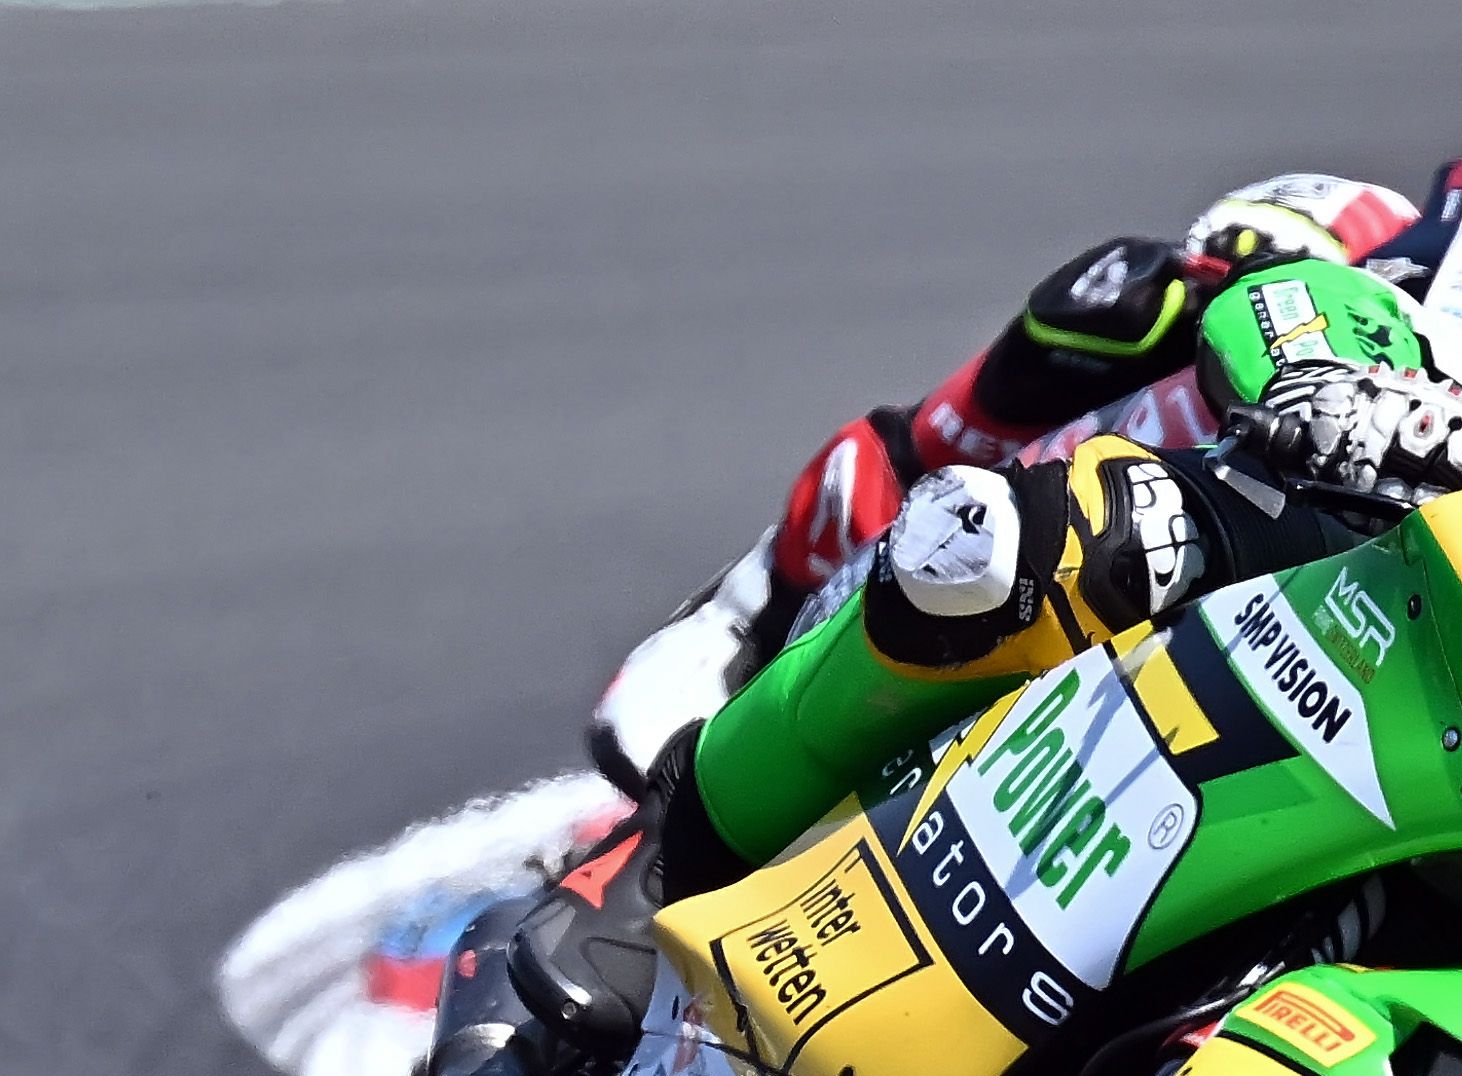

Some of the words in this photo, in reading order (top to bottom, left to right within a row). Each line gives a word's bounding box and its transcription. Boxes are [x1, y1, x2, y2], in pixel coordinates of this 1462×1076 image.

[799, 876, 862, 947] inter
[747, 919, 827, 1026] wetten
[1253, 990, 1356, 1053] PIRELLI
